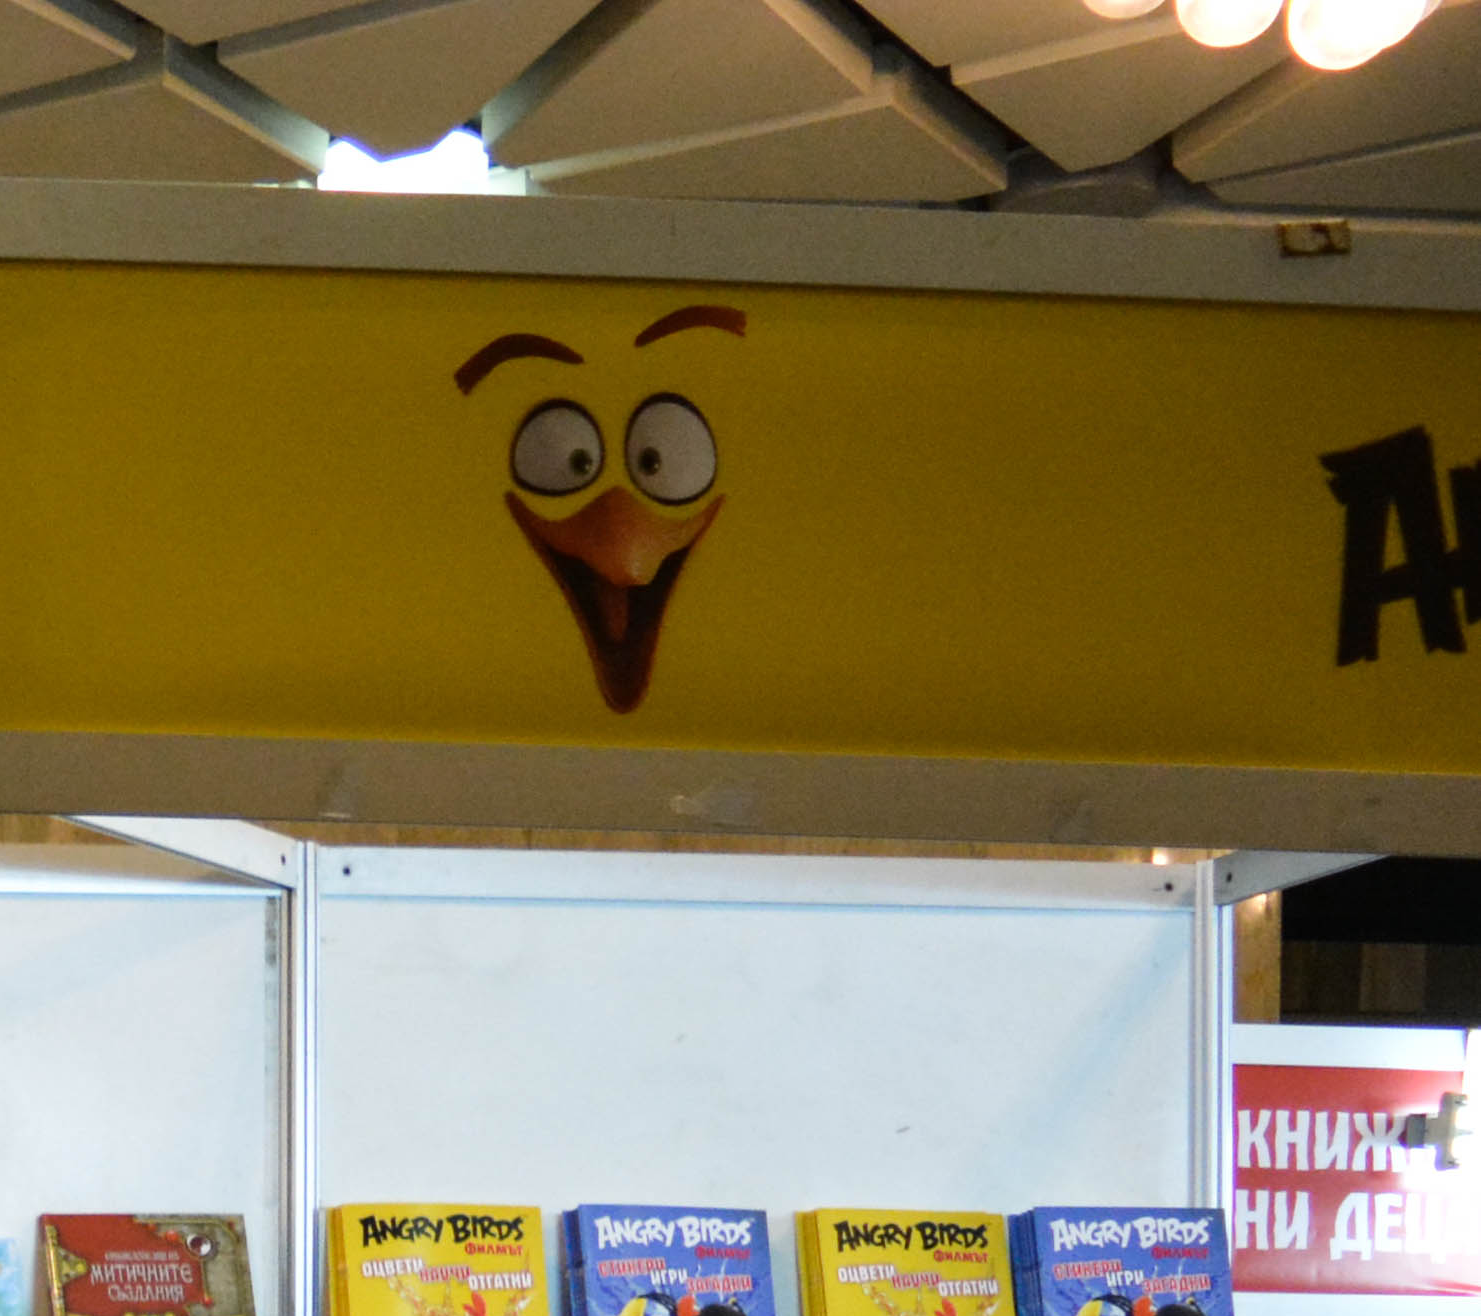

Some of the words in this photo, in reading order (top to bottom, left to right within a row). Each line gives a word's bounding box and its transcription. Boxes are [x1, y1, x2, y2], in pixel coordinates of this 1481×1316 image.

[1237, 1108, 1412, 1172] КНИЖ
[359, 1215, 443, 1247] ANGRY
[447, 1213, 525, 1244] BIRDS
[595, 1215, 679, 1248] ANGRY
[682, 1214, 752, 1246] BIRDS
[835, 1221, 917, 1252] ANGRY
[921, 1220, 989, 1250] BIRDS
[1052, 1217, 1133, 1251] ANGRY
[1137, 1217, 1210, 1247] BIRDS
[1235, 1189, 1309, 1250] НИ
[1330, 1191, 1450, 1264] ДЕЦ
[465, 1242, 524, 1257] ФИЛМЪТ
[933, 1250, 989, 1263] ФИЛМЪТ
[361, 1257, 425, 1278] ОЦВЕТИ
[598, 1257, 666, 1278] СТИКЕРИ
[650, 1267, 689, 1286] ИГРИ
[838, 1263, 896, 1284] ОЦВЕТИ
[1053, 1260, 1122, 1279] СТИКЕРИ
[1106, 1269, 1144, 1287] ИГРИ
[468, 1271, 532, 1291] ОТГАТНИ
[938, 1277, 999, 1296] ОТГАТНИ
[1142, 1275, 1211, 1293] ЗАГАДКИ
[107, 1282, 186, 1303] СЪЗДАНИЯ
